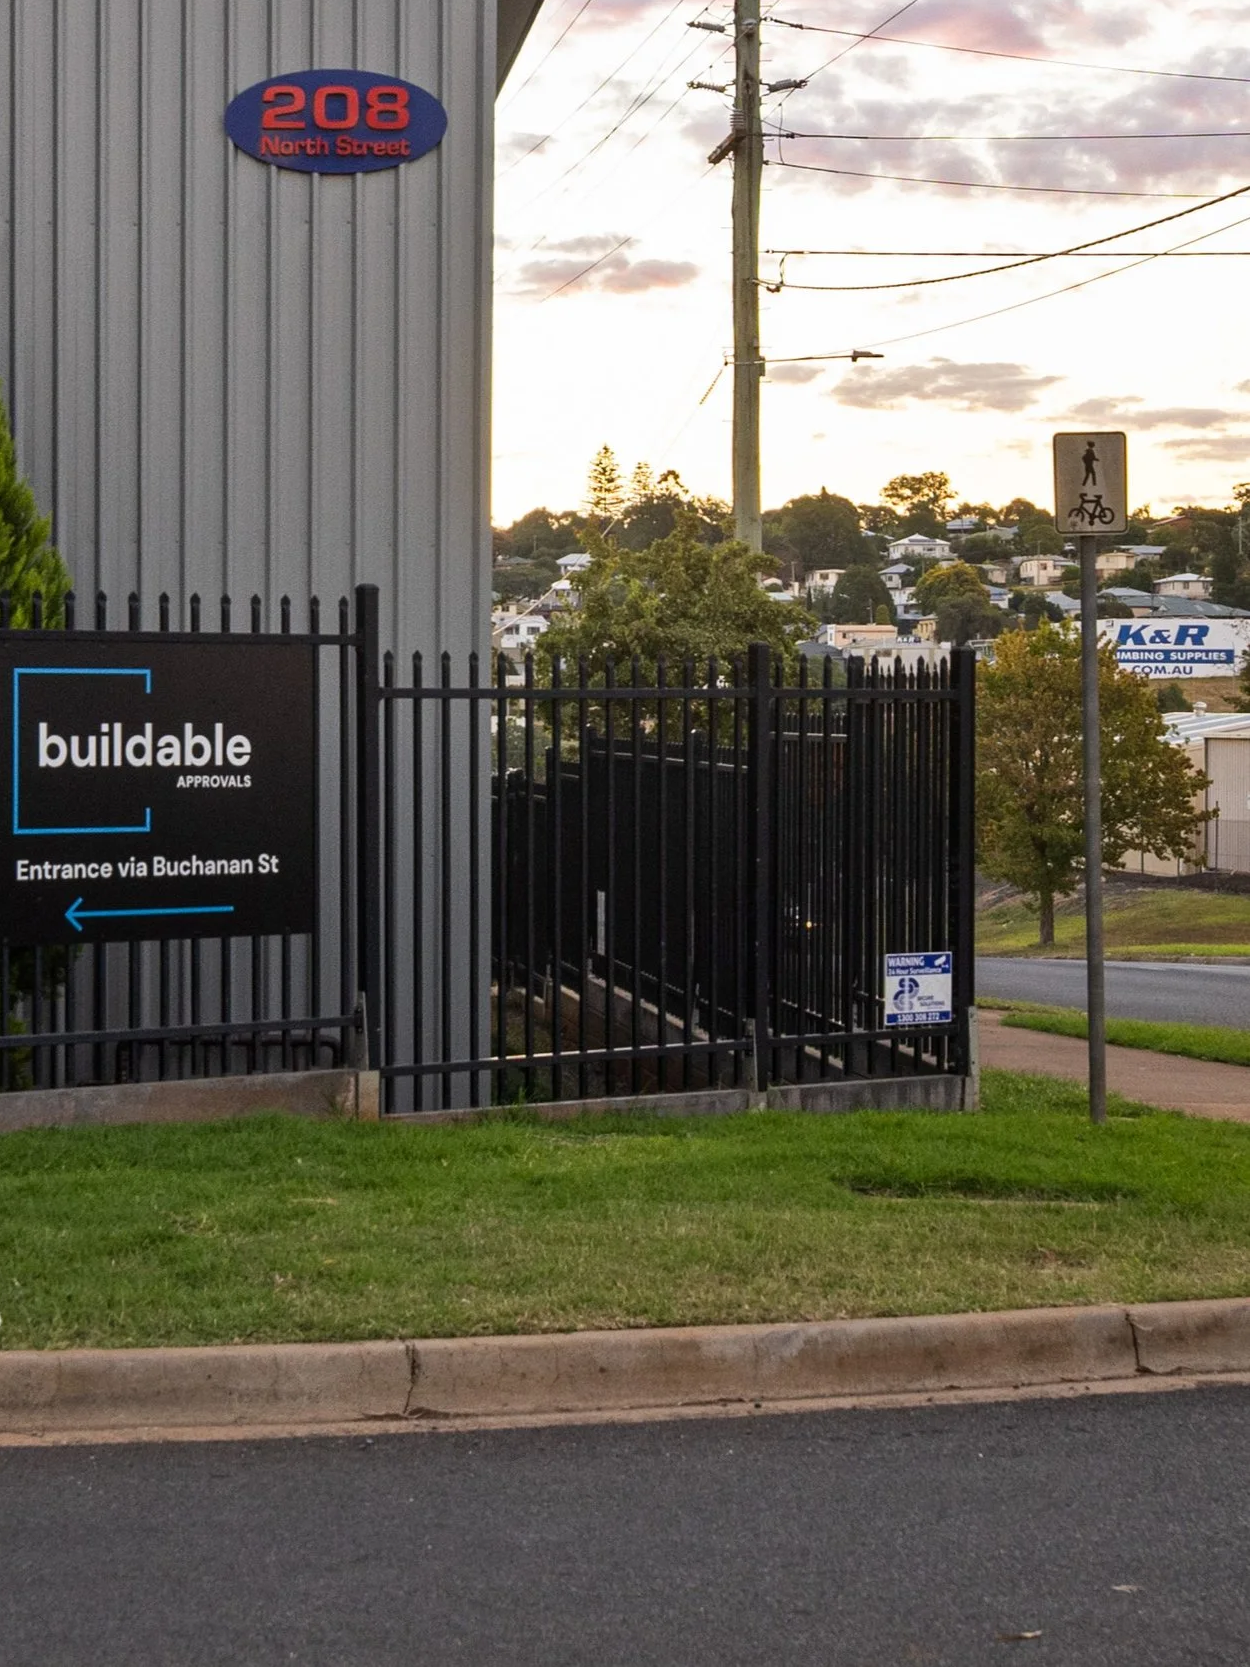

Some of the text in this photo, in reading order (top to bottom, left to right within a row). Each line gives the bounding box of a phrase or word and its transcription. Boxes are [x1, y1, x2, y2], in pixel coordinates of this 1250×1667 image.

[261, 85, 411, 131] 208
[259, 135, 411, 157] North Street
[1117, 624, 1210, 645] K&R
[1113, 651, 1227, 661] UMBING SUPPLIES
[38, 722, 252, 768] buildable
[176, 775, 252, 788] APPROVALS
[16, 853, 280, 882] Entrance via Buchanan St
[888, 956, 924, 967] WARNING
